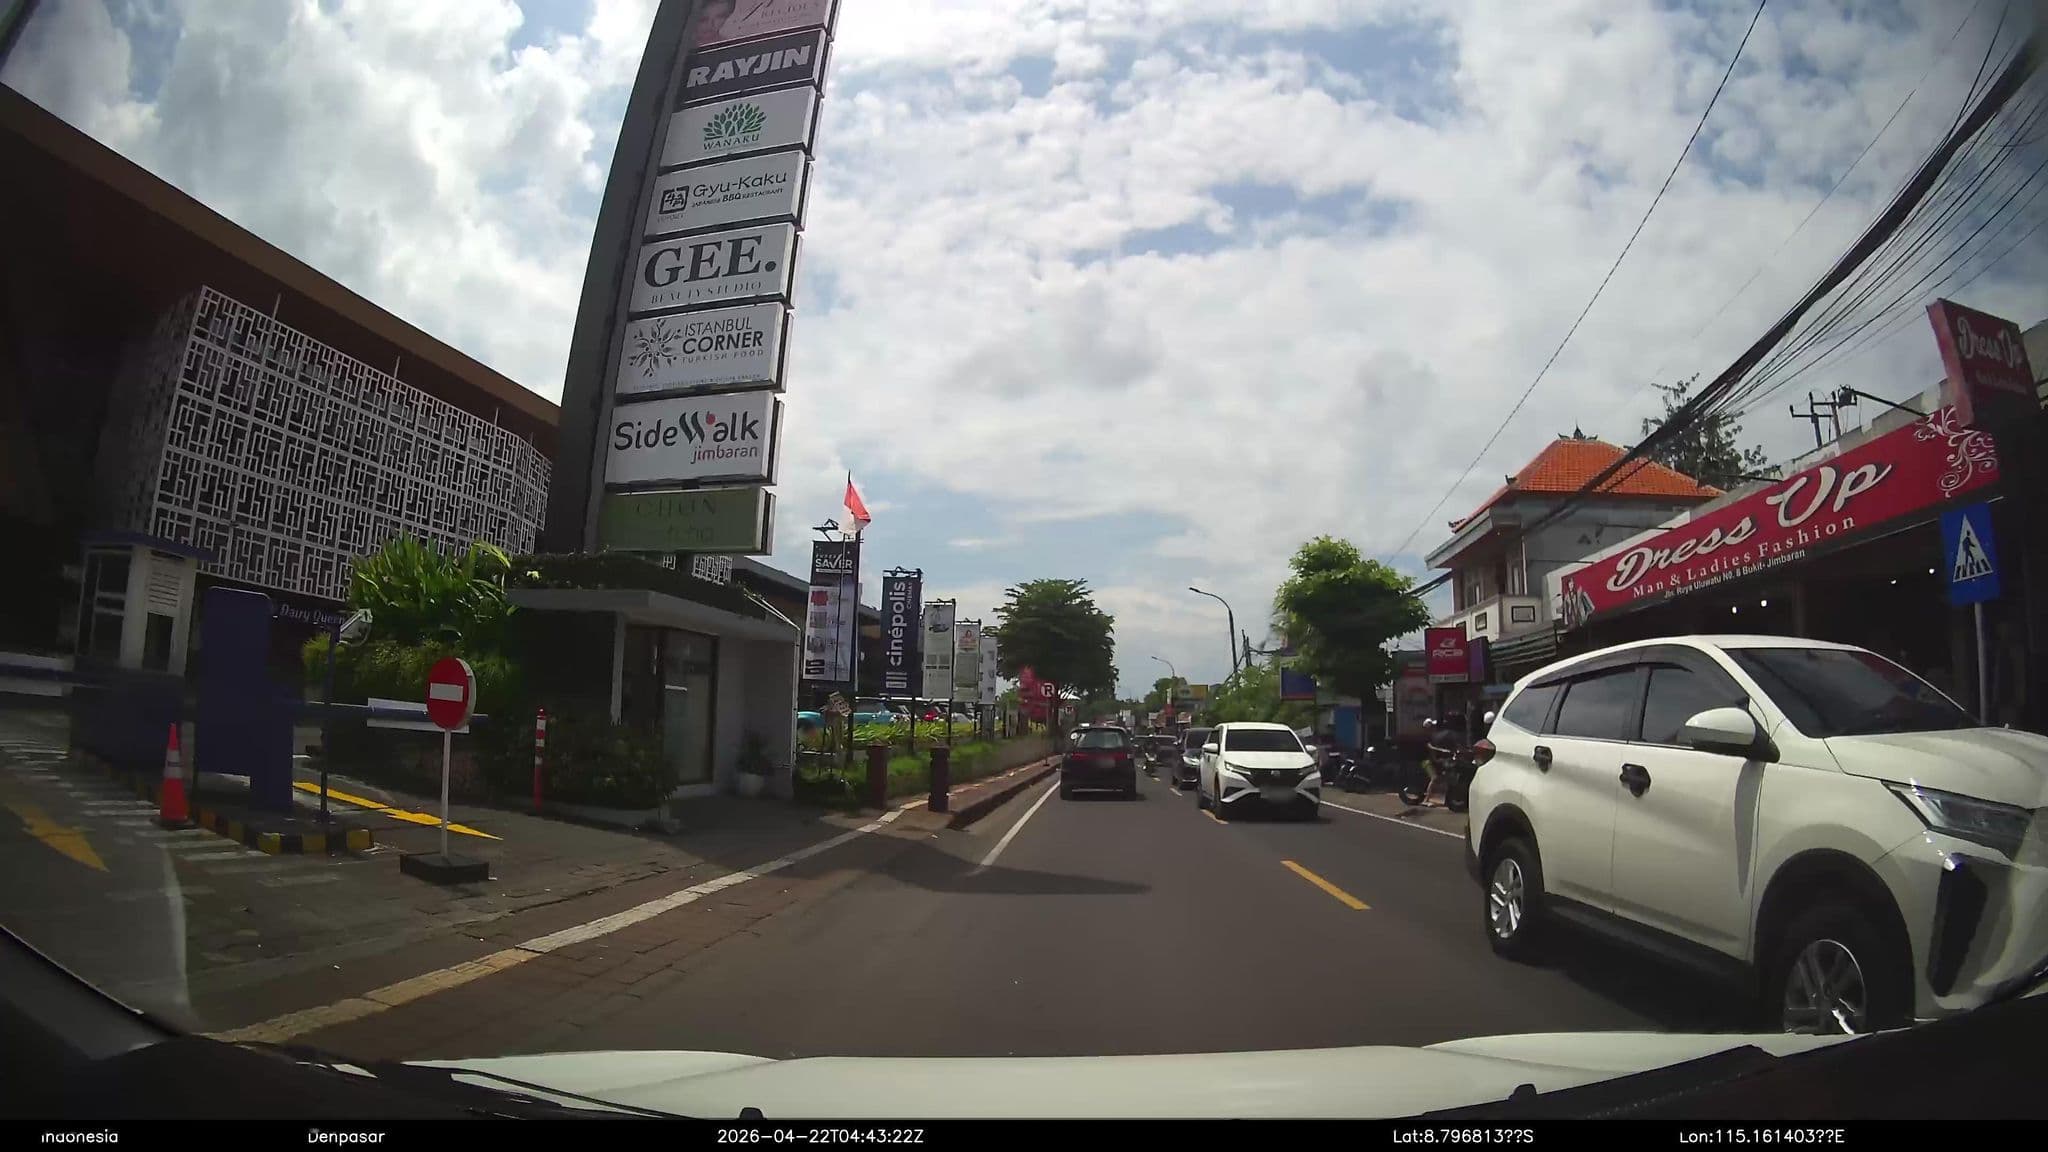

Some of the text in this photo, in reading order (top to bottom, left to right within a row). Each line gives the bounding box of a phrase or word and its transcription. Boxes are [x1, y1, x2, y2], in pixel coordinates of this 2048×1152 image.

[686, 45, 811, 88] RAYJIN
[703, 133, 760, 150] WANAKU
[693, 172, 787, 198] Gyu-Kaku
[722, 193, 741, 203] BBQ
[644, 235, 777, 288] GEE.
[684, 316, 752, 337] ISTANBUL
[682, 330, 764, 355] CORNER
[682, 350, 764, 364] TURKISH FOOD
[614, 411, 759, 451] SideWalk
[690, 446, 758, 464] jimbaran
[1607, 464, 1892, 592] Dress Up
[815, 554, 853, 569] SAVER
[1633, 516, 1856, 598] Man & Ladies Fashion
[1694, 576, 1722, 591] Uluwatu
[1766, 549, 1805, 568] Jimbaran
[280, 604, 345, 625] Dairy Queen
[886, 582, 907, 667] cinépolis
